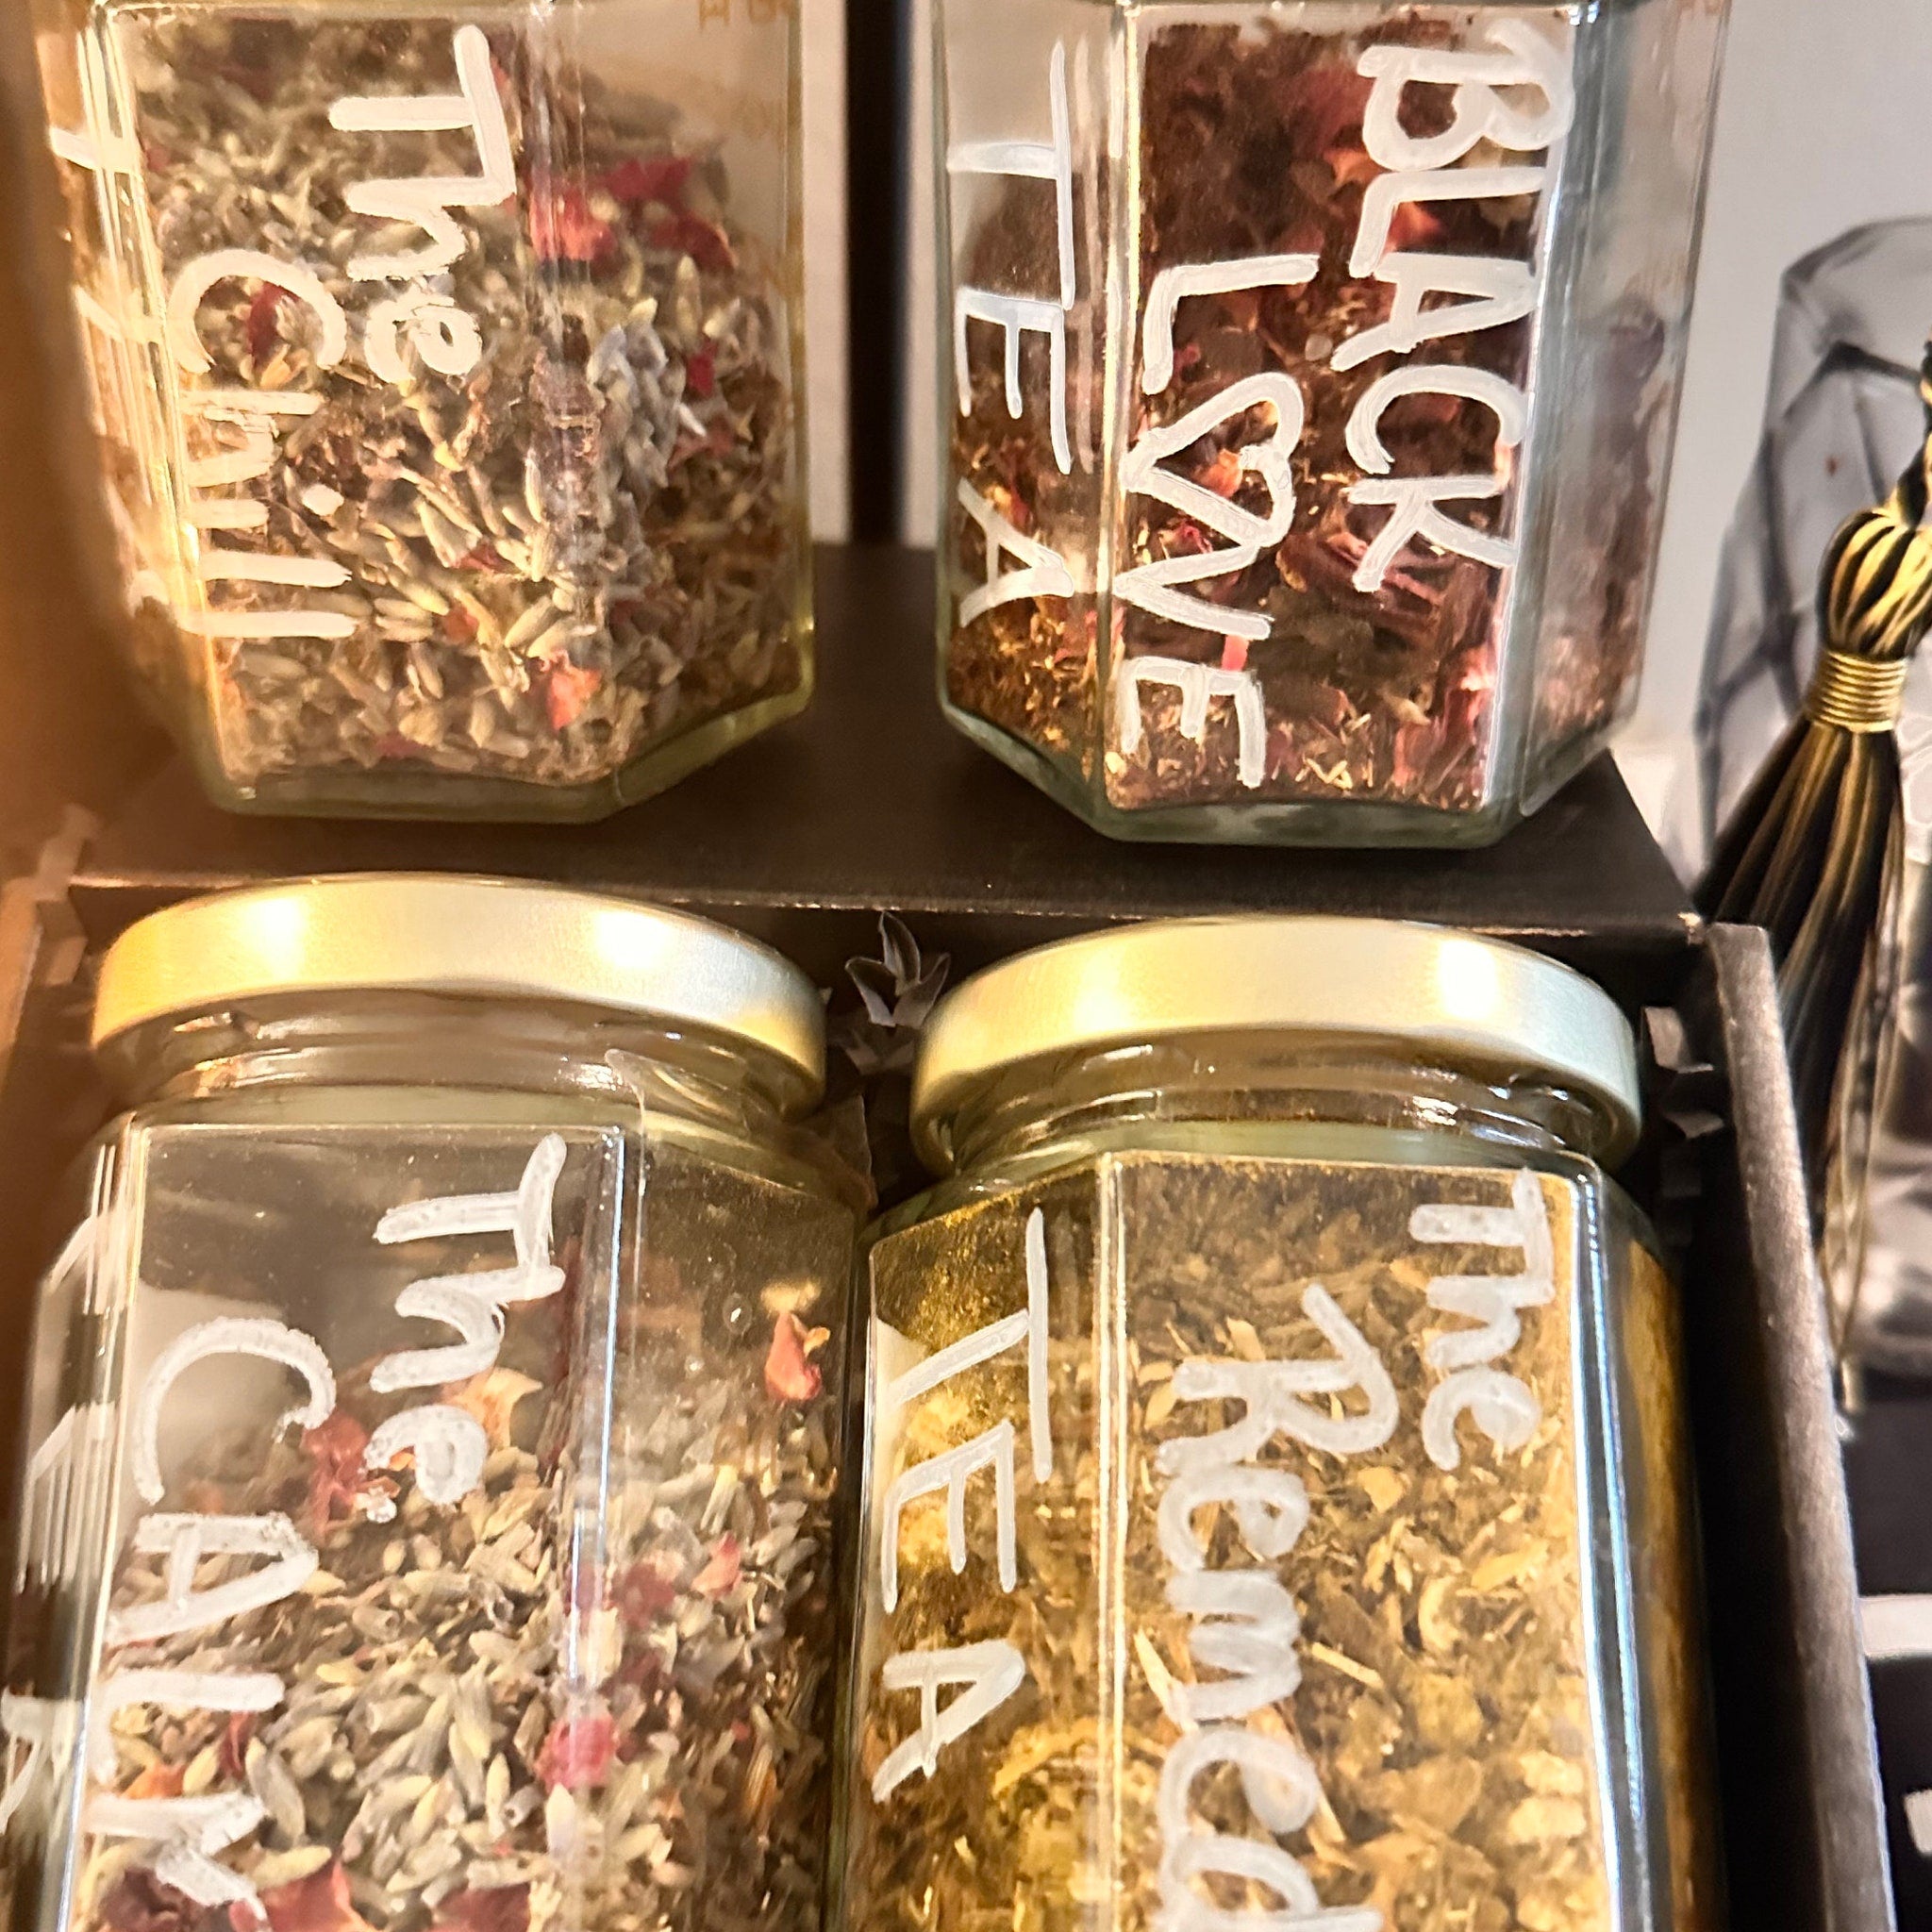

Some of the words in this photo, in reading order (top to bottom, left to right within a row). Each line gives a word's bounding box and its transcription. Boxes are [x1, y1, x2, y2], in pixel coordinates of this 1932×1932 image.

[329, 25, 517, 385] The
[947, 41, 1074, 627] TEA
[1331, 18, 1576, 591] BLACK
[167, 250, 358, 639] Chill
[364, 1133, 566, 1522] The
[872, 1208, 1052, 1803] TEA
[1408, 1168, 1555, 1471] The
